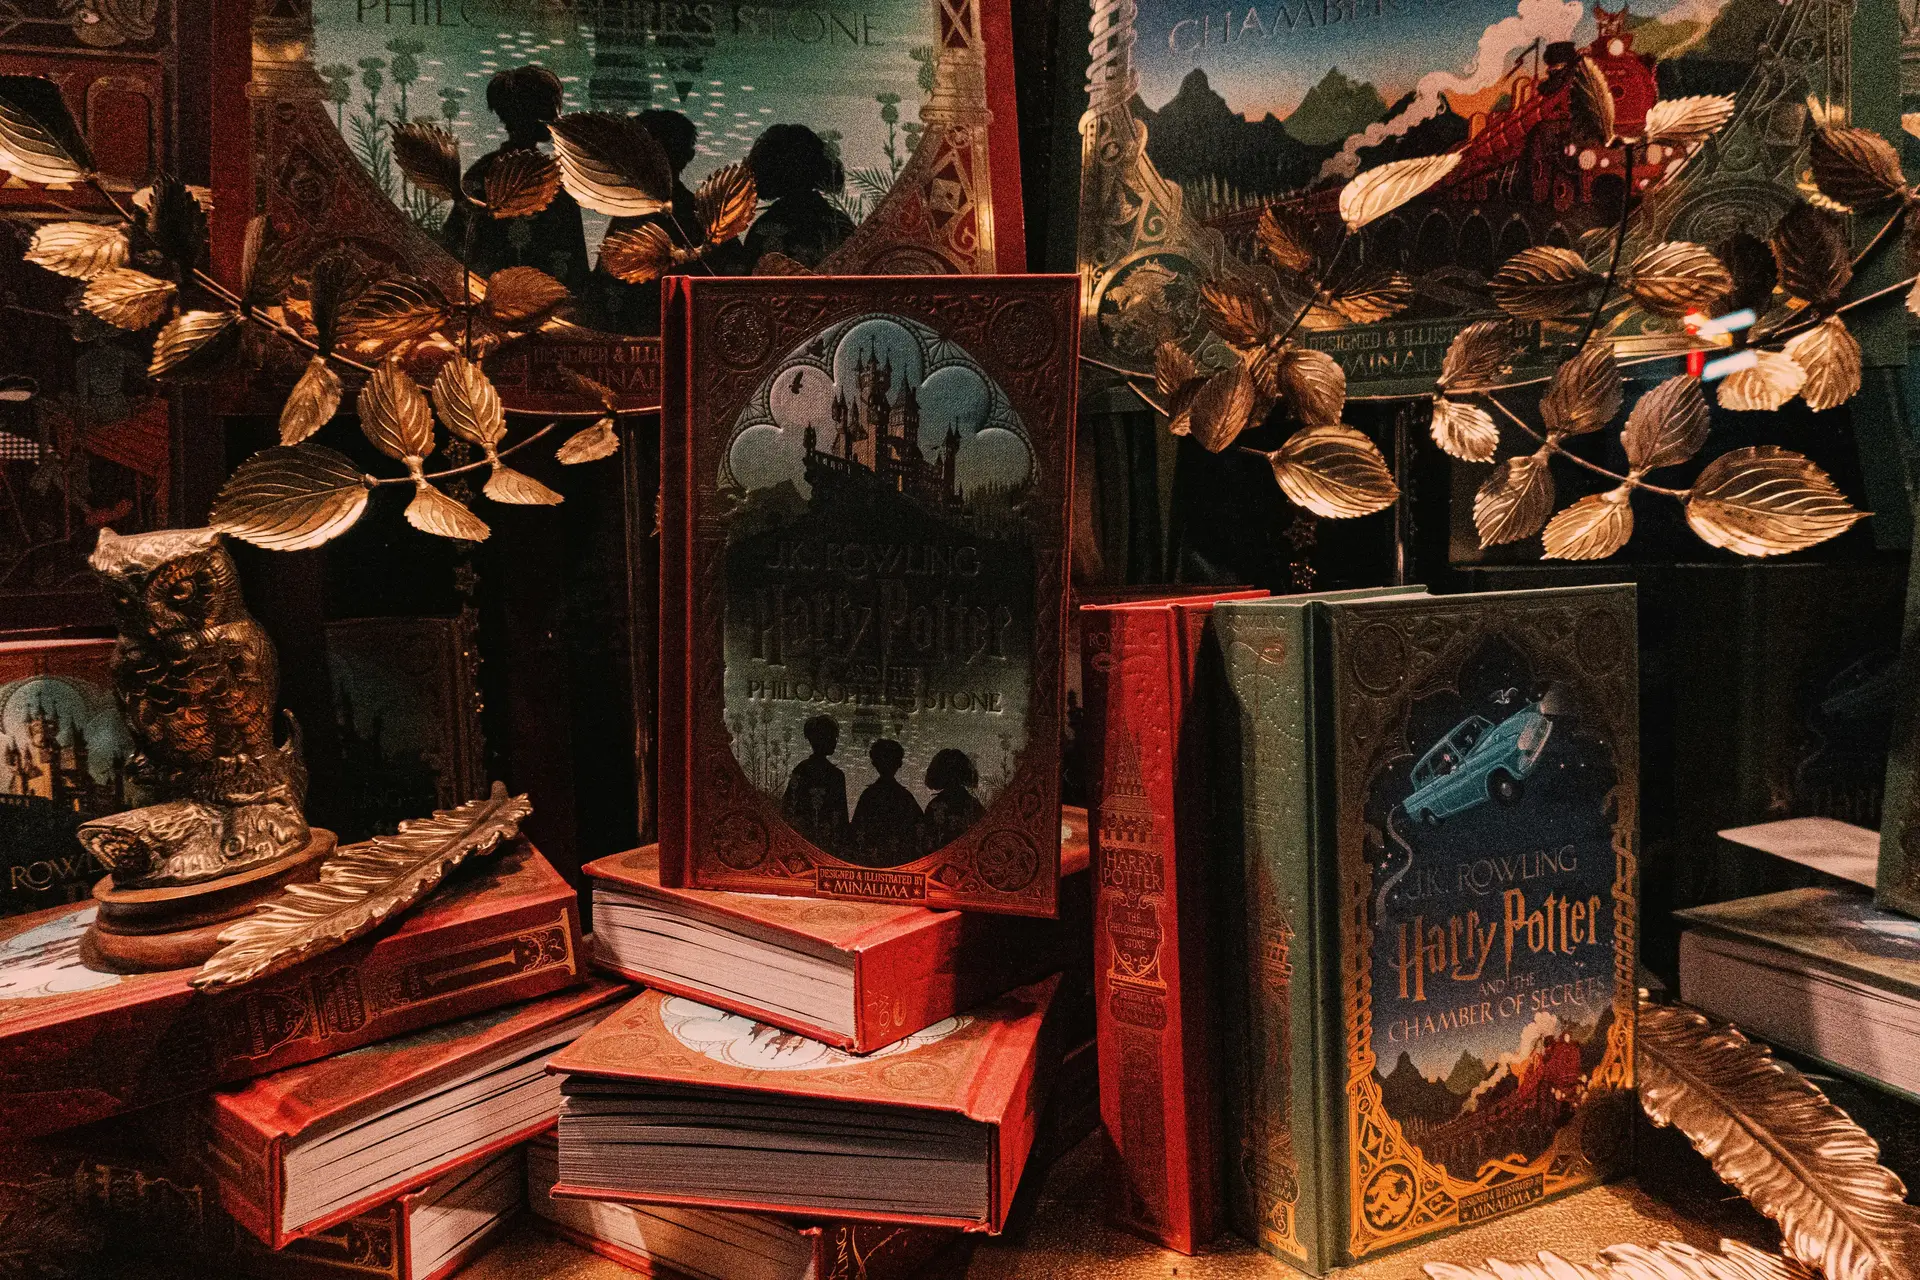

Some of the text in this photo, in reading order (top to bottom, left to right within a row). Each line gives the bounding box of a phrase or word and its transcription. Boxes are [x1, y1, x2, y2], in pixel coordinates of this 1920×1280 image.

[1402, 326, 1463, 348] ILLUST
[826, 543, 981, 580] ROWLING
[922, 691, 1004, 714] STONE
[9, 852, 102, 891] ROWL
[1106, 851, 1157, 873] HARRY
[1457, 844, 1578, 895] ROWLING
[820, 868, 924, 886] DESIGNED & ILLUSTRATED BY
[833, 880, 908, 898] MINALIMA
[1103, 867, 1163, 891] POTTER
[1124, 938, 1147, 951] STONE
[1387, 887, 1601, 1002] Harry Potter
[1478, 971, 1536, 998] AND THE
[1388, 974, 1606, 1043] CHAMBER OF SECRETS
